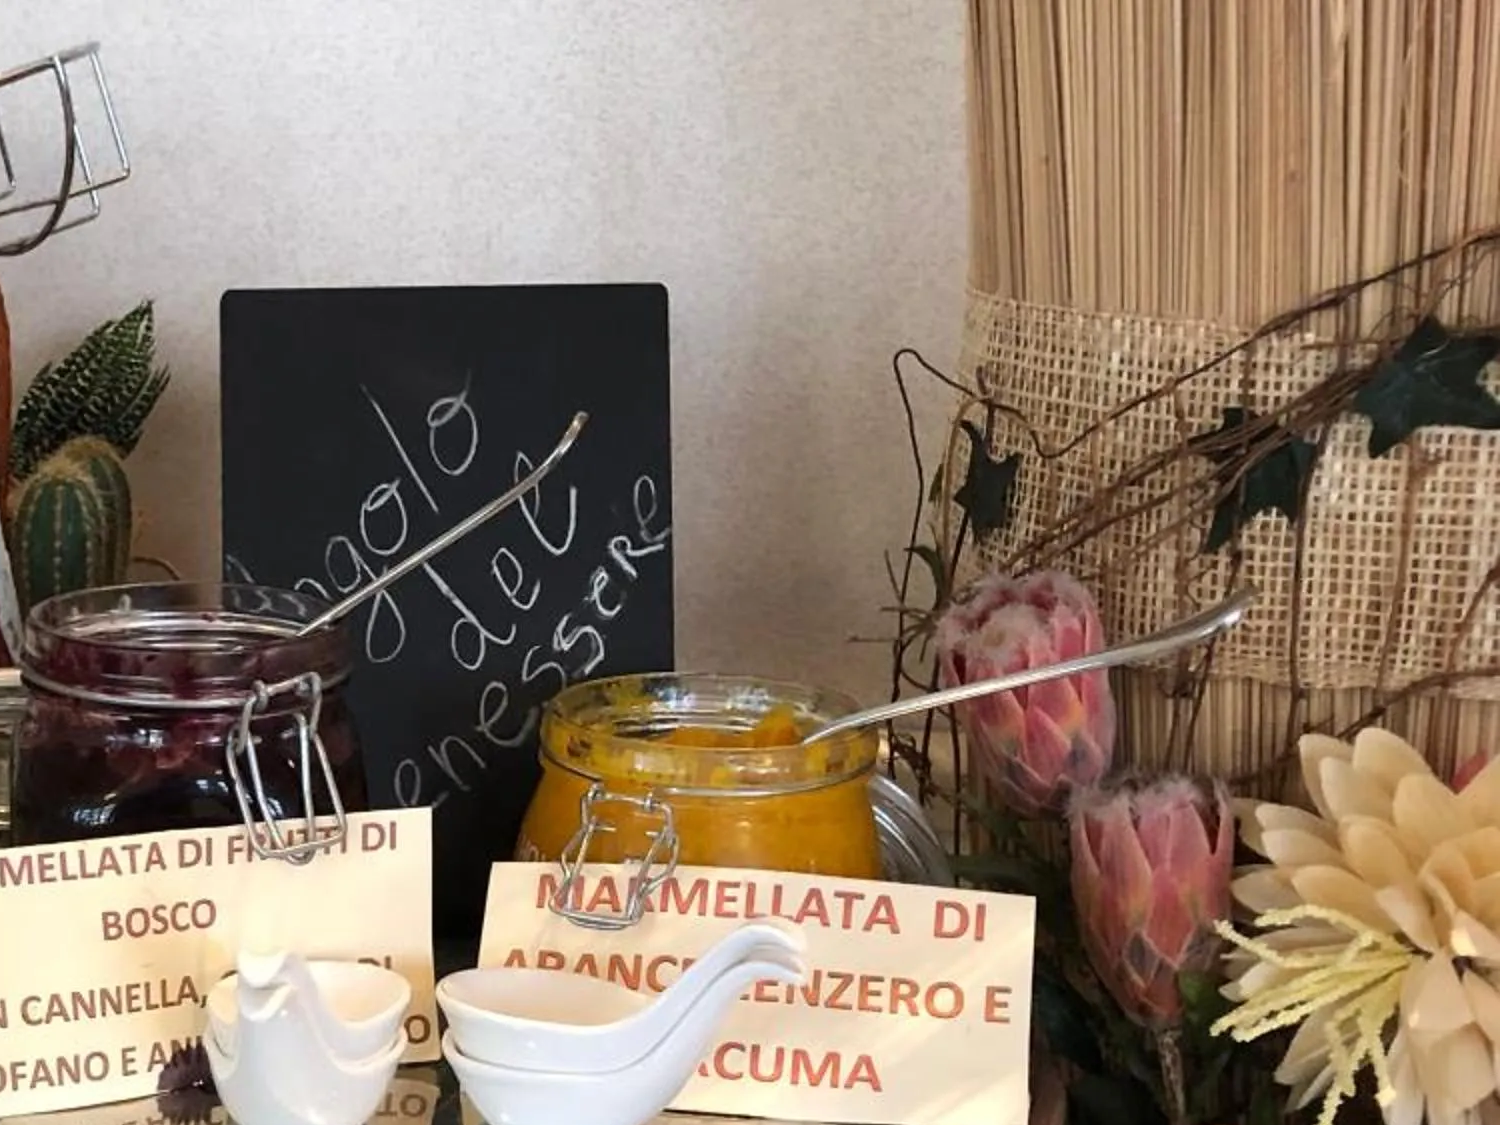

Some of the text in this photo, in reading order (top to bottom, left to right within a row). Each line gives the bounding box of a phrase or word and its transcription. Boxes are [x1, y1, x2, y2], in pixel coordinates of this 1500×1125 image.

[178, 837, 213, 869] DI
[361, 821, 397, 851] DI
[102, 898, 217, 942] BOSCO
[536, 873, 988, 942] MARMELLATA DI
[20, 974, 209, 1029] CANNELLA,
[739, 968, 965, 1020] ENZERO
[984, 986, 1013, 1023] E
[121, 1046, 138, 1076] E
